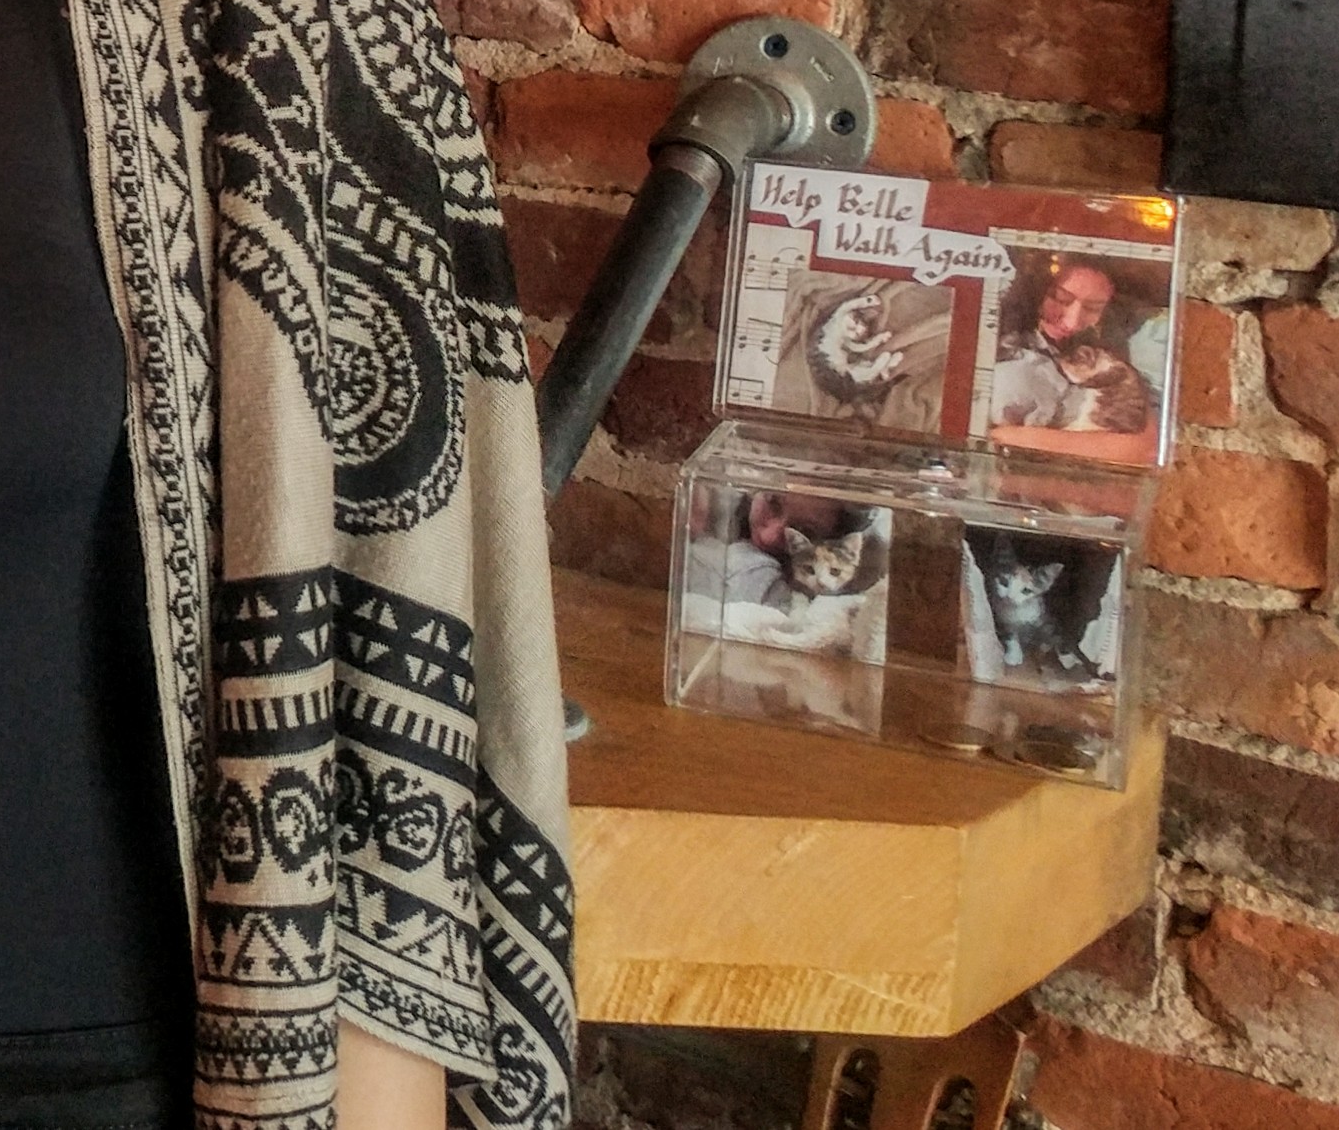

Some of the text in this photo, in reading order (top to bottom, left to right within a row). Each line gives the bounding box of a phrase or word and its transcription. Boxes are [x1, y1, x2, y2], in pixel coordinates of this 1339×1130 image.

[761, 173, 914, 222] Help Belle
[835, 223, 1015, 279] Walk Again.
